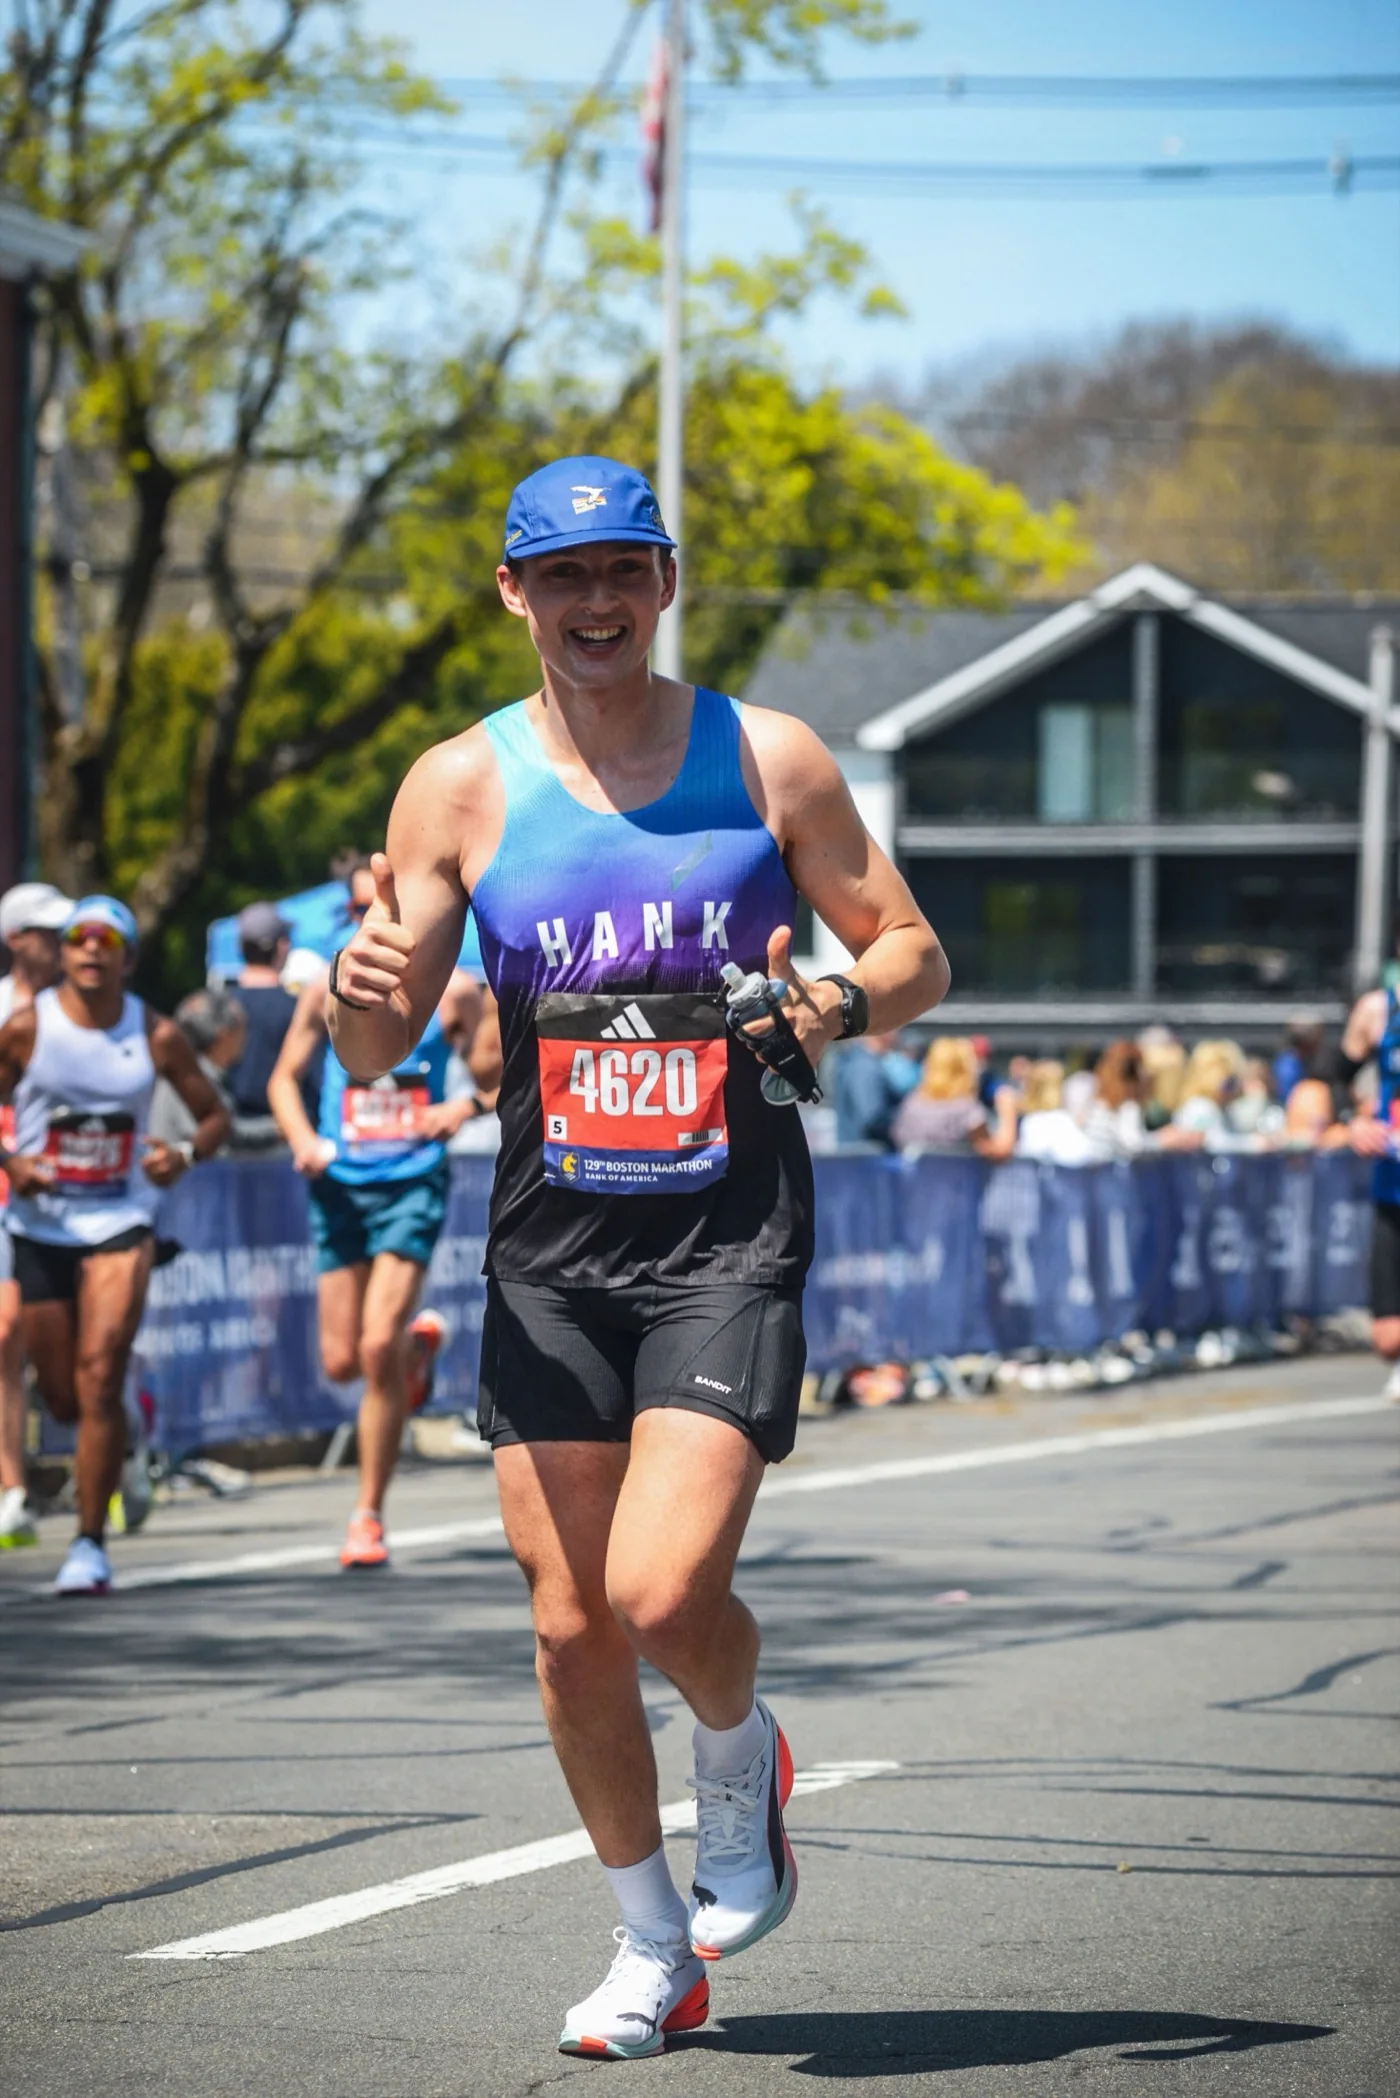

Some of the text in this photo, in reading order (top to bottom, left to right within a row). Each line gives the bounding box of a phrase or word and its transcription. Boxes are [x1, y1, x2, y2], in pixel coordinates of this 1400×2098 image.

[536, 901, 732, 967] HANK
[569, 1047, 698, 1117] 4620
[553, 1121, 562, 1134] 5
[607, 1161, 649, 1173] BOSTON
[651, 1159, 713, 1173] MARATHON
[585, 1173, 607, 1181] BANK
[620, 1174, 658, 1182] AMERICA
[694, 1375, 732, 1395] BANDIT
